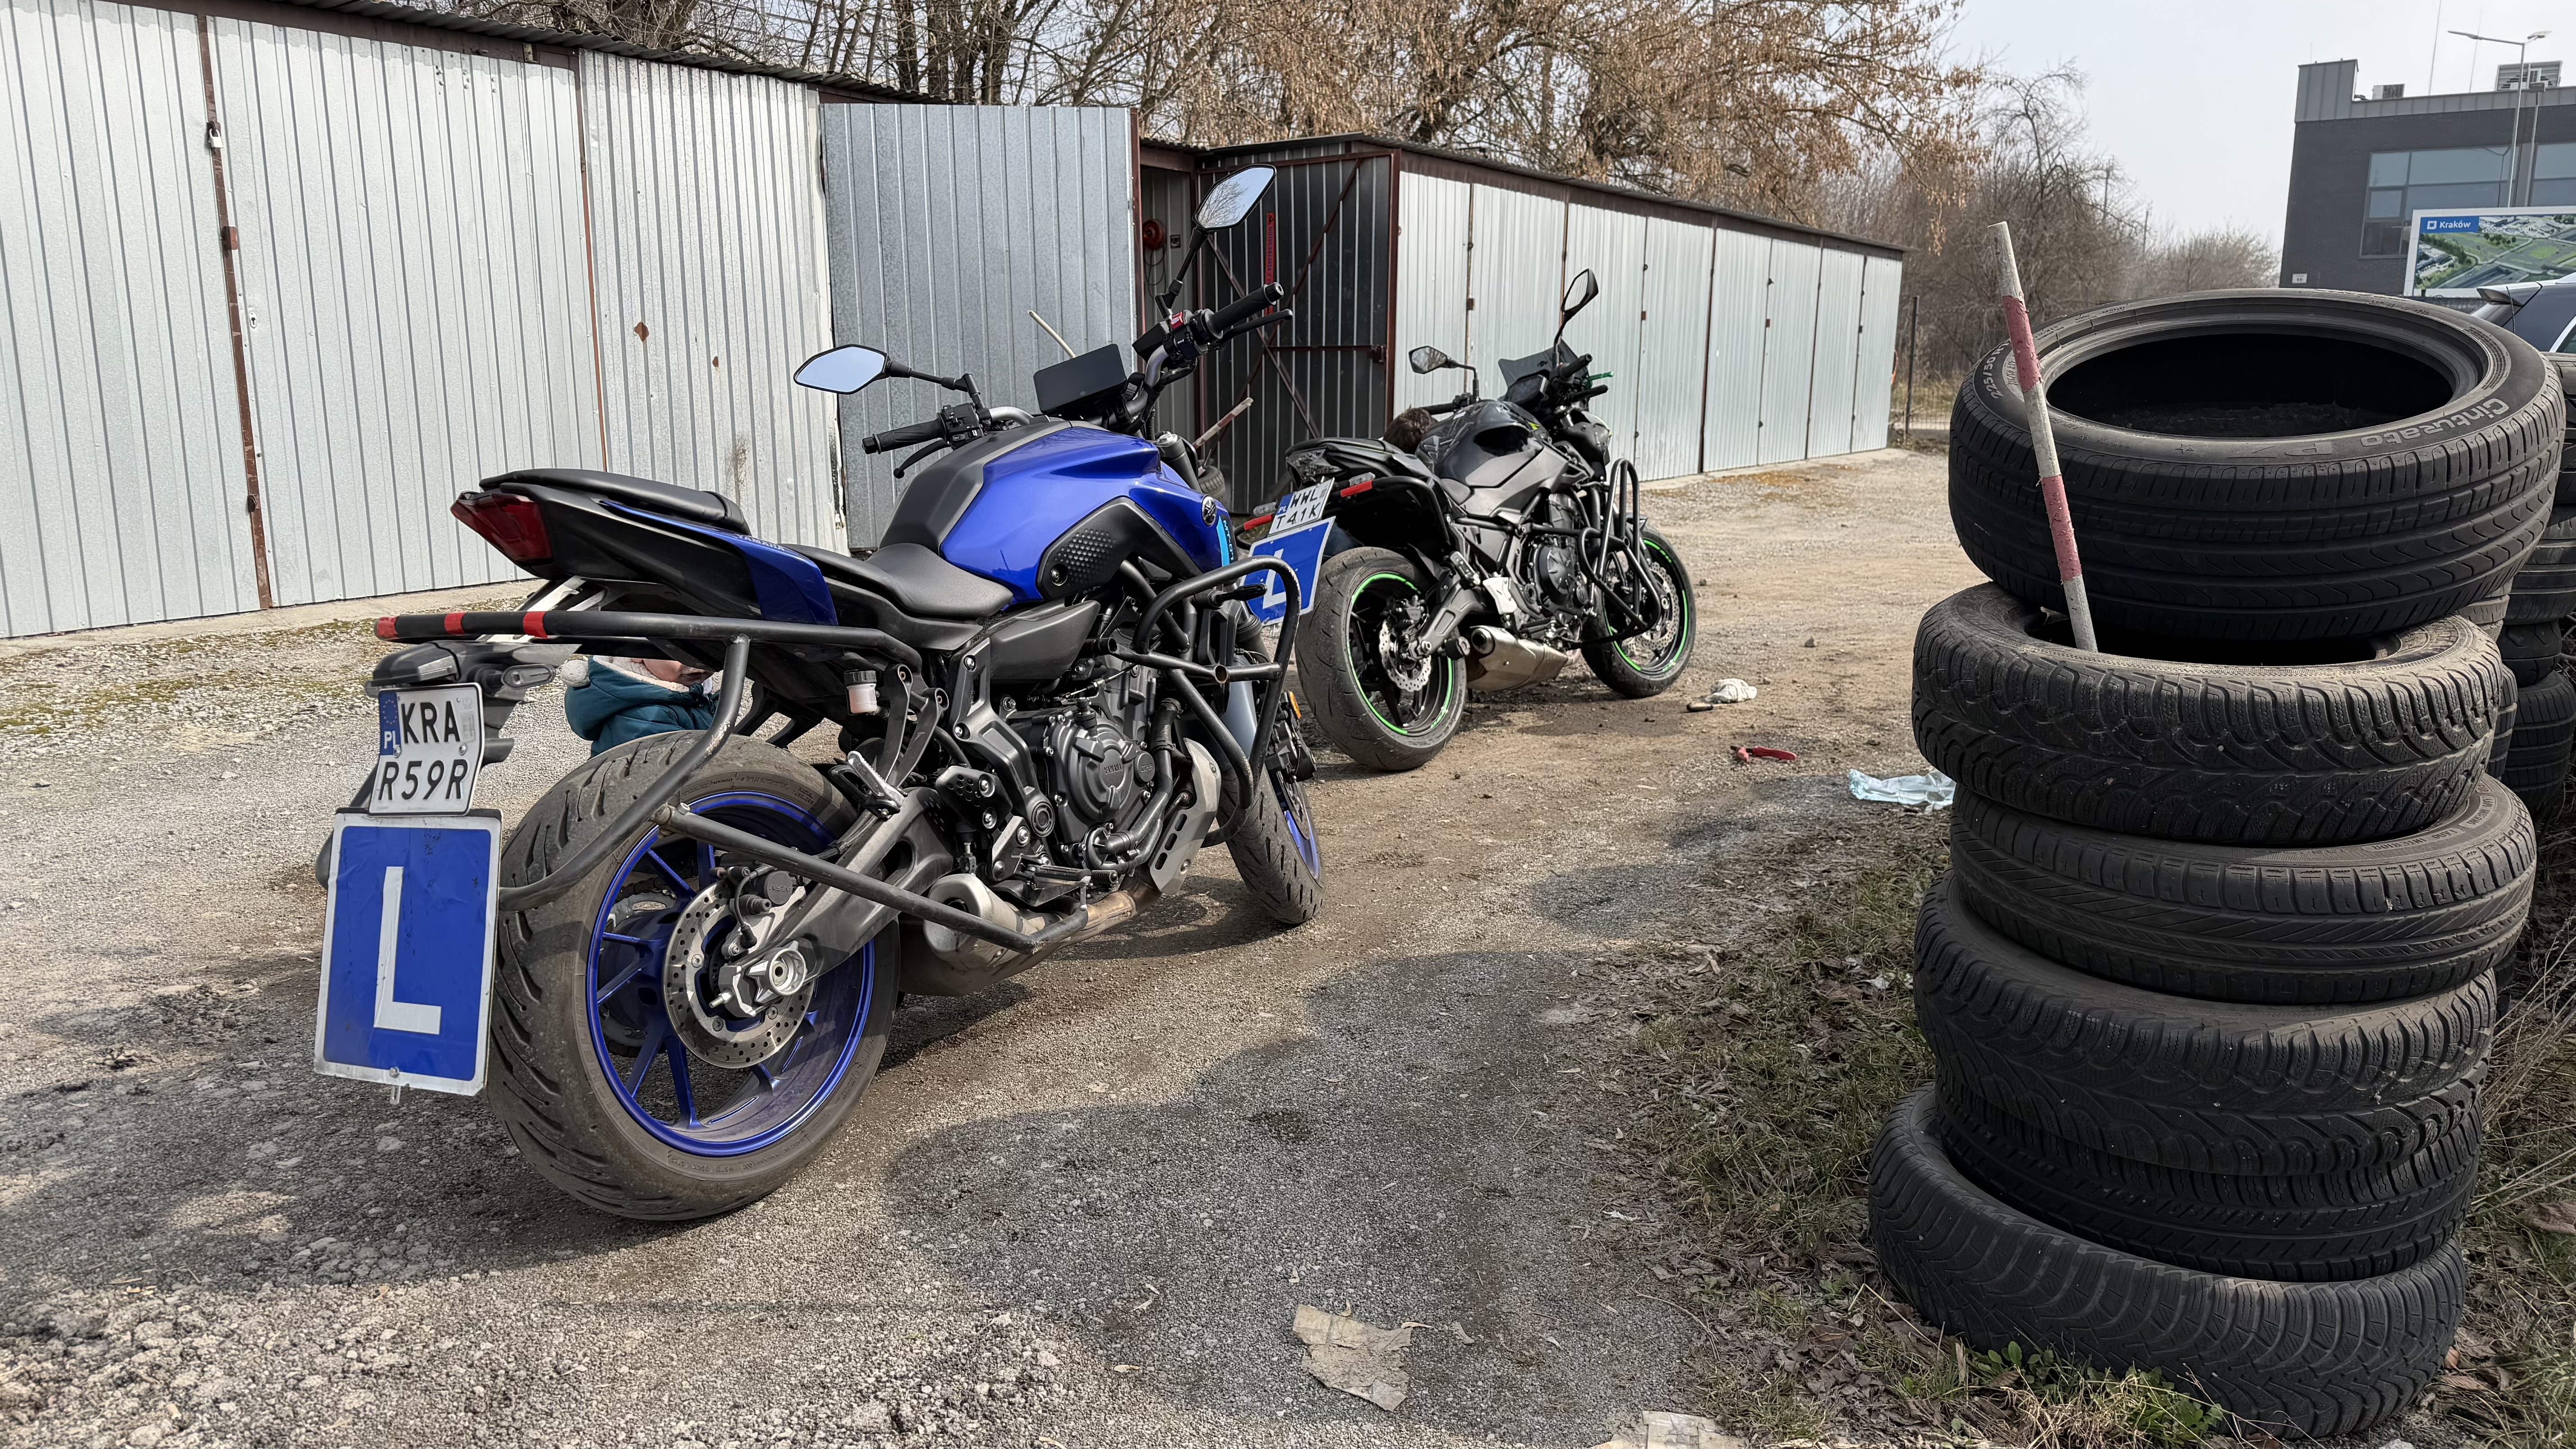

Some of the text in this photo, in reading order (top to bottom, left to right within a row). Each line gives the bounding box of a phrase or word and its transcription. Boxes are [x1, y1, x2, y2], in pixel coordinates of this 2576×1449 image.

[2439, 219, 2471, 229] Kraków
[1983, 356, 2004, 400] 225/50
[2360, 398, 2510, 447] Cinturato
[1277, 505, 1288, 515] PL
[1289, 488, 1318, 509] WWL
[1276, 502, 1321, 529] T41K
[738, 534, 786, 552] YAMAHA
[1262, 548, 1287, 609] L
[400, 700, 460, 744] KRA
[383, 730, 400, 749] PL
[377, 759, 469, 800] R59R
[1104, 763, 1122, 775] YAMAHA
[2371, 829, 2458, 851] LADO INTERIOR
[373, 866, 442, 1035] L
[575, 995, 630, 1129] MICHELIN
